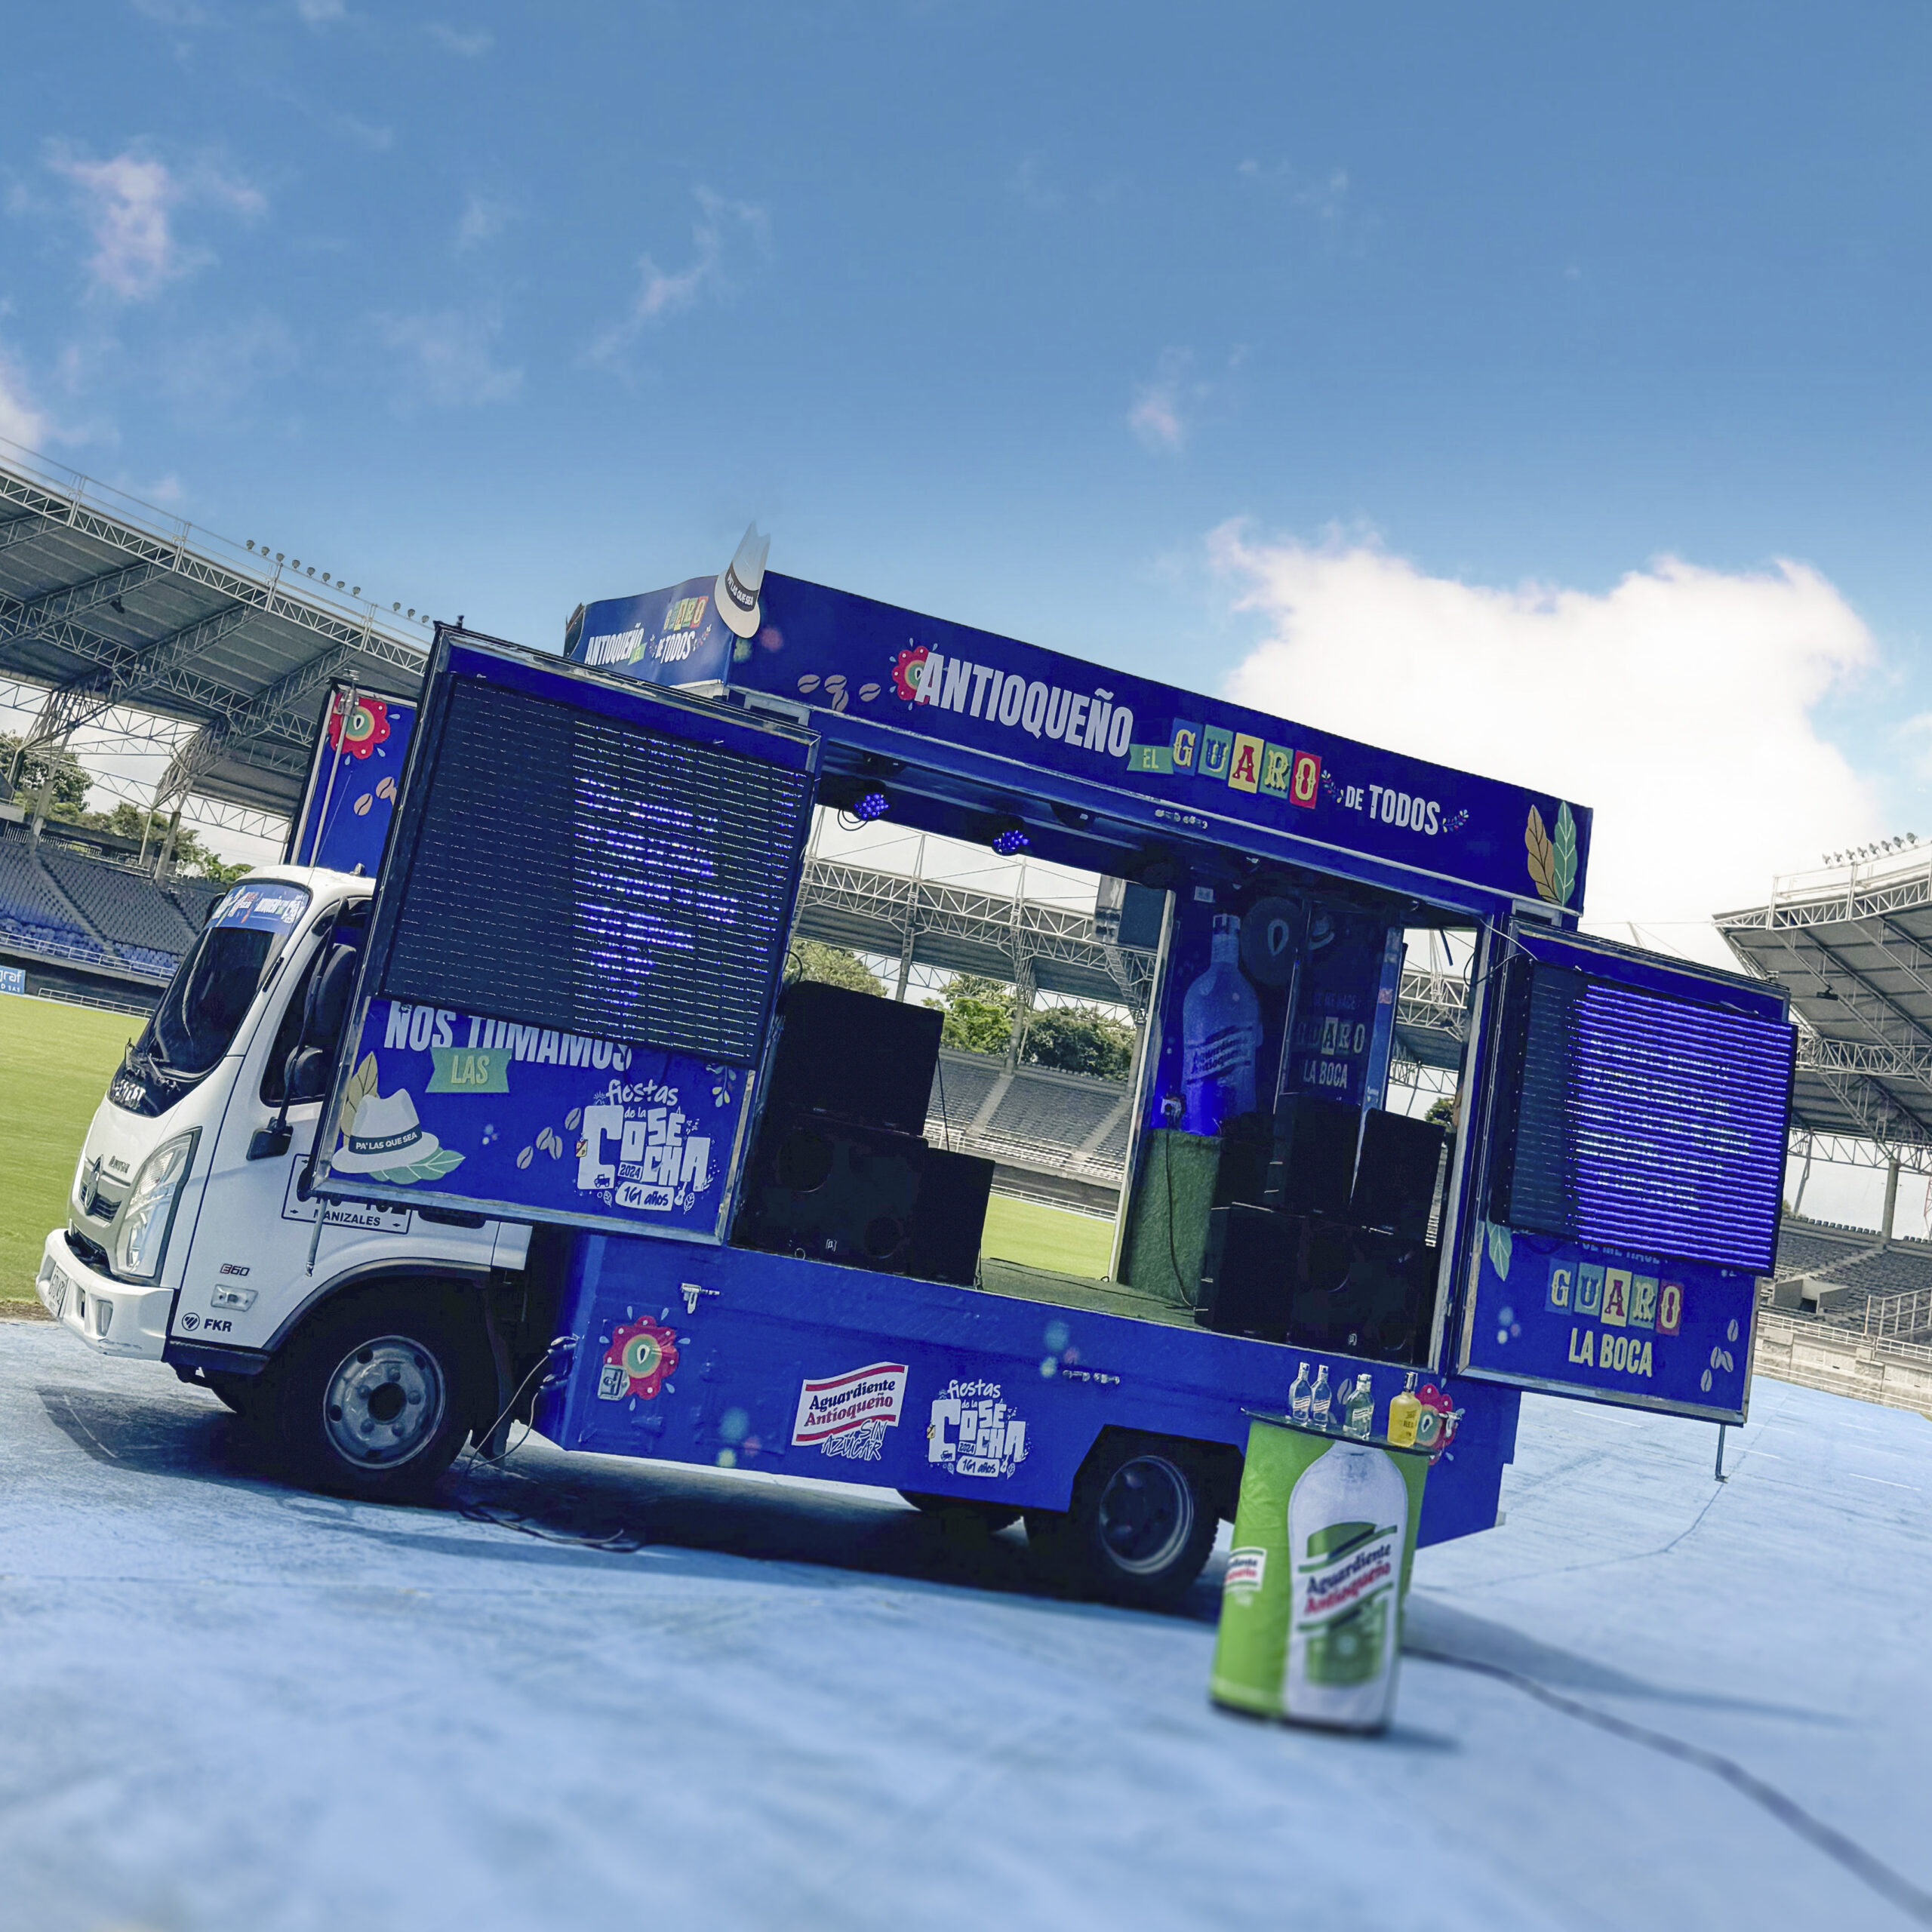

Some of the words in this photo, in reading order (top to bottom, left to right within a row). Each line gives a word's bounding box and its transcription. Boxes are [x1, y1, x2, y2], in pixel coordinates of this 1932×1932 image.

[584, 623, 645, 666] ANTIOQUEÑO
[660, 631, 696, 664] TODOS
[914, 651, 1134, 758] ANTIOQUEÑO
[1142, 747, 1159, 770] EL
[1173, 728, 1316, 802] GUARO
[1346, 785, 1364, 811] DE
[1369, 784, 1441, 836] TODOS
[383, 1000, 457, 1052] NOS
[451, 1054, 490, 1085] LAS
[1303, 1059, 1317, 1084] LA
[1318, 1060, 1348, 1090] BOCA
[605, 1078, 679, 1106] fiestas
[638, 1106, 647, 1118] la
[368, 1141, 385, 1150] LAS
[385, 1137, 403, 1148] QUE
[402, 1131, 418, 1143] SEA
[577, 1105, 711, 1192] COSECHA
[619, 1163, 641, 1179] 2024
[623, 1186, 642, 1206] 161
[644, 1190, 669, 1207] años
[1551, 1269, 1681, 1330] GUARO
[203, 1318, 232, 1333] FKR
[1568, 1327, 1594, 1367] LA
[1599, 1333, 1653, 1378] BOCA
[808, 1380, 896, 1413] Aguardiente
[946, 1378, 1001, 1400] fiestas
[971, 1399, 978, 1408] la
[803, 1392, 894, 1427] Antioqueño
[860, 1419, 888, 1442] SIN
[928, 1398, 1026, 1463] COSECHA
[1306, 1543, 1392, 1595] Aguardiente
